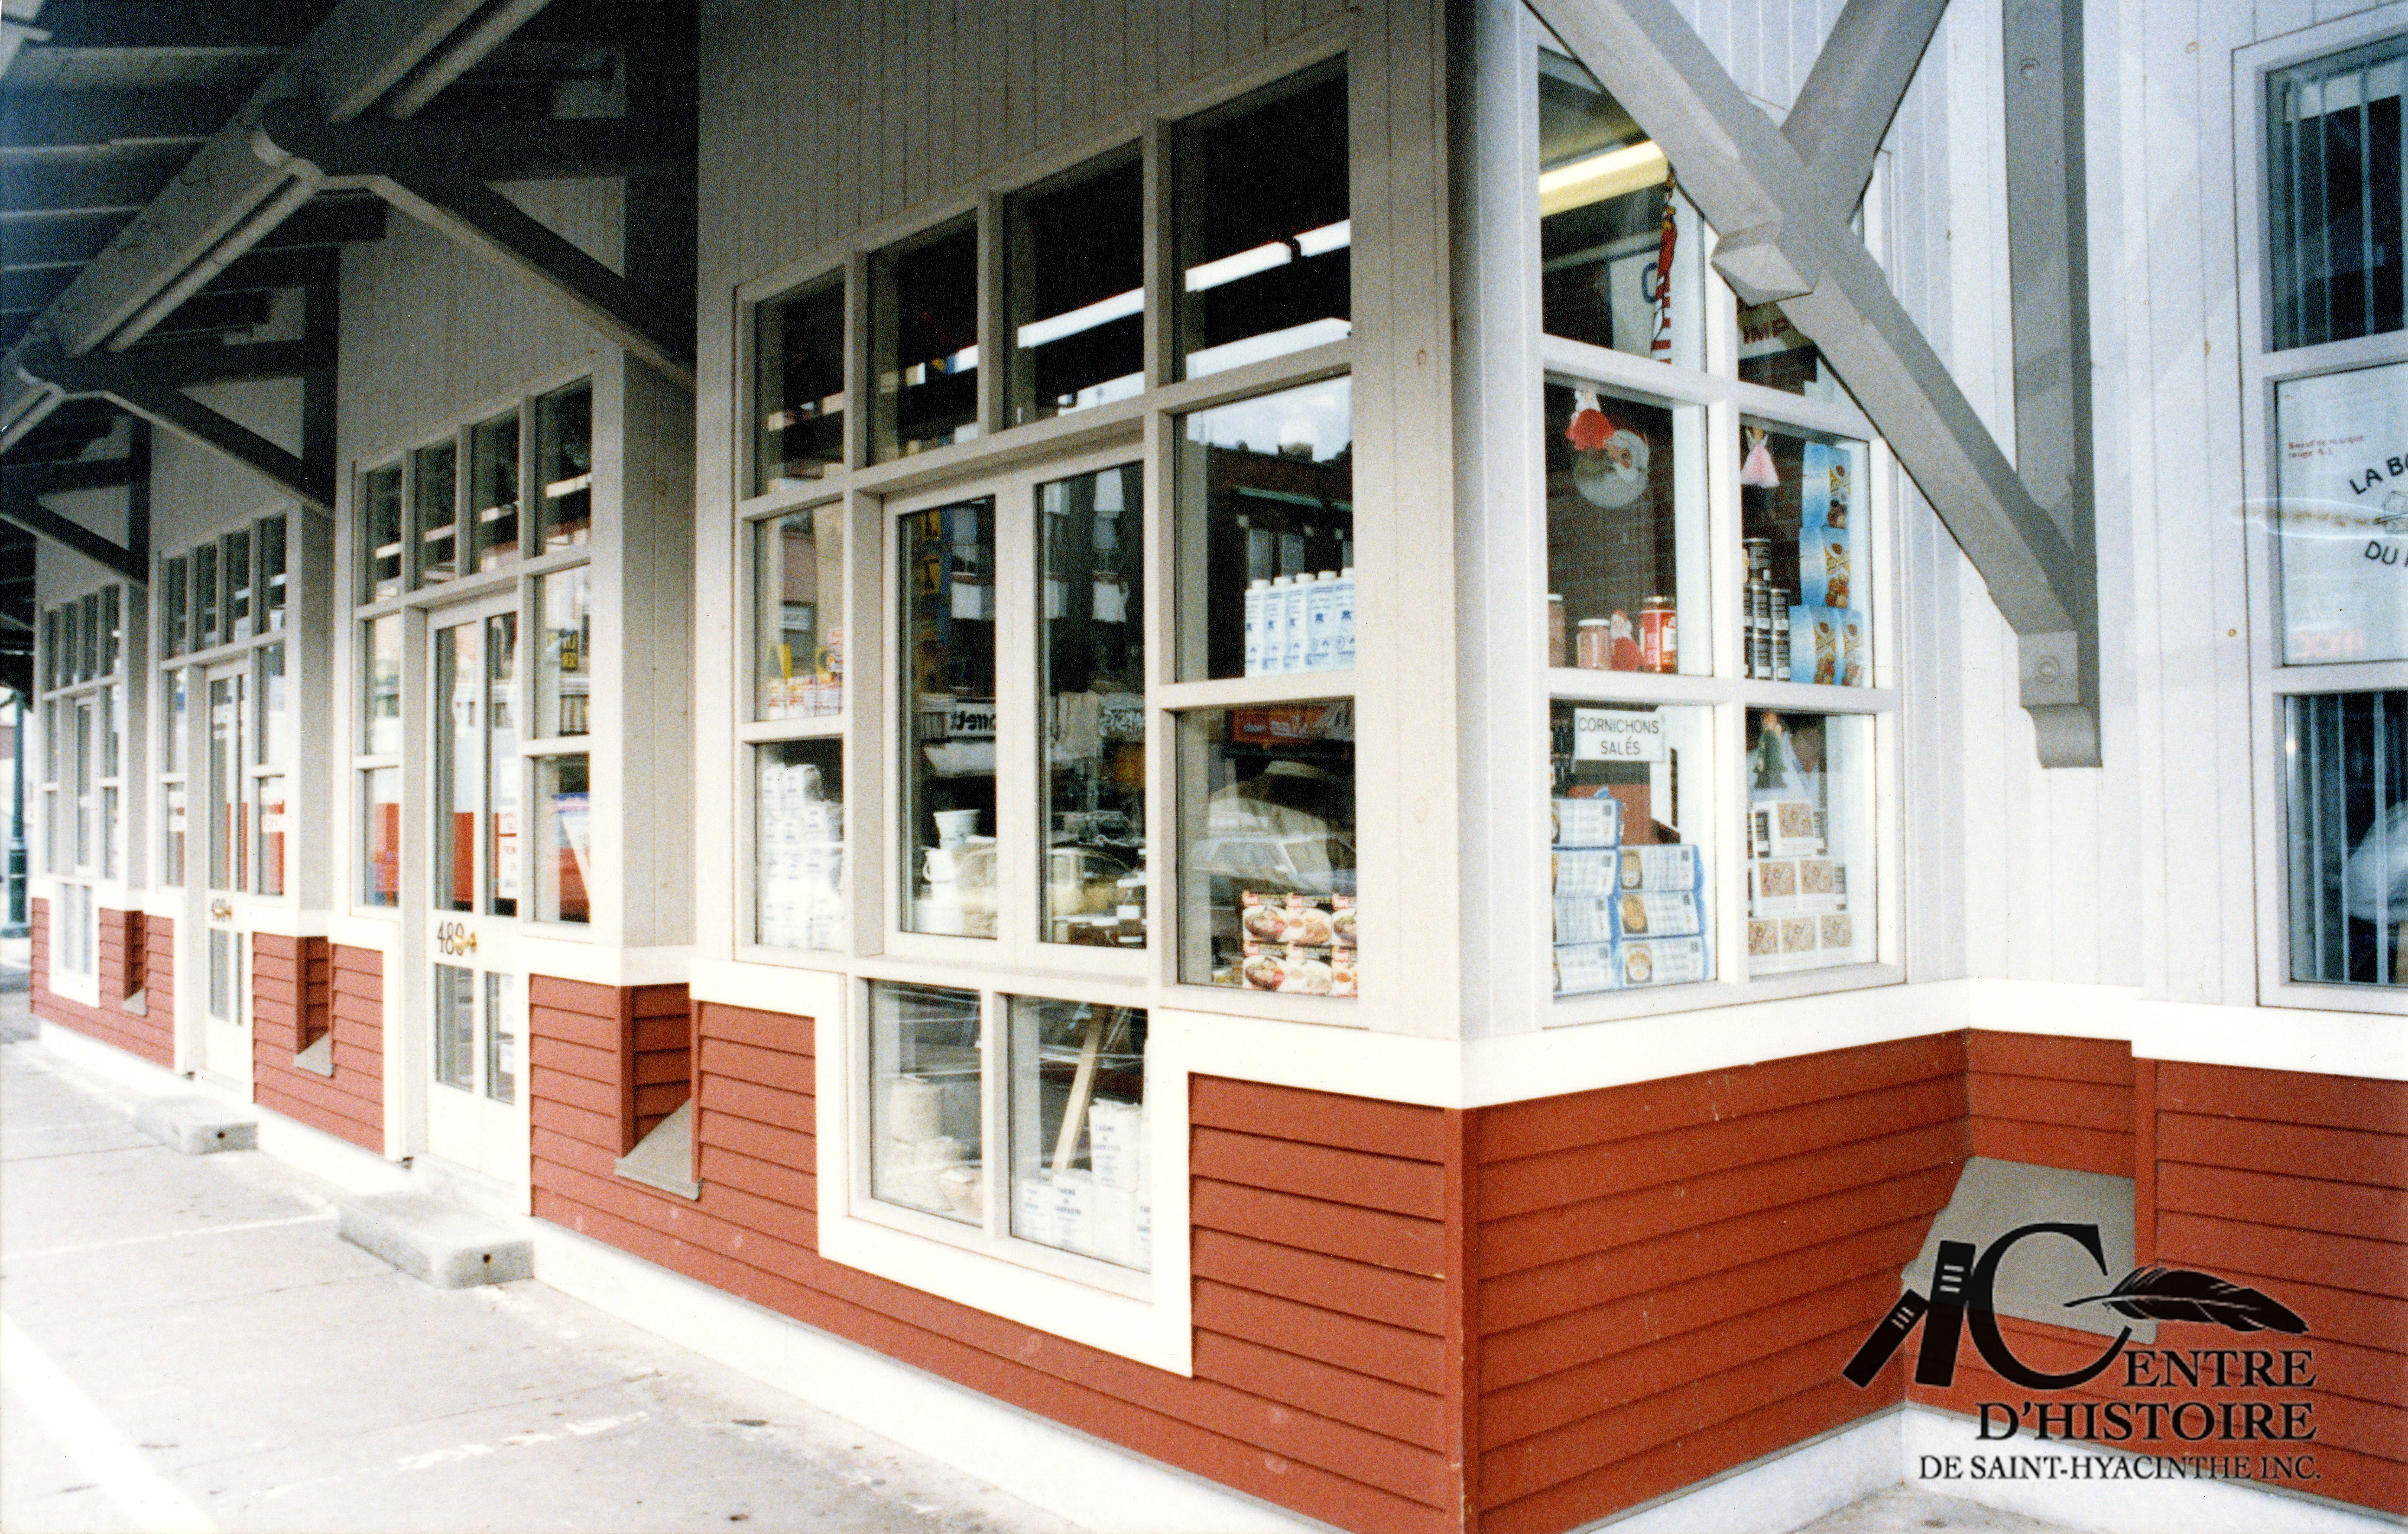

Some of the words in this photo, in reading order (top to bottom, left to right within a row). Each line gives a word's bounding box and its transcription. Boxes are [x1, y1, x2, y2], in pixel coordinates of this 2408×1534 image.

[2349, 468, 2383, 495] LA
[2364, 540, 2399, 565] DU
[1578, 717, 1659, 734] CORNICHONS
[1600, 736, 1640, 755] SALÉS
